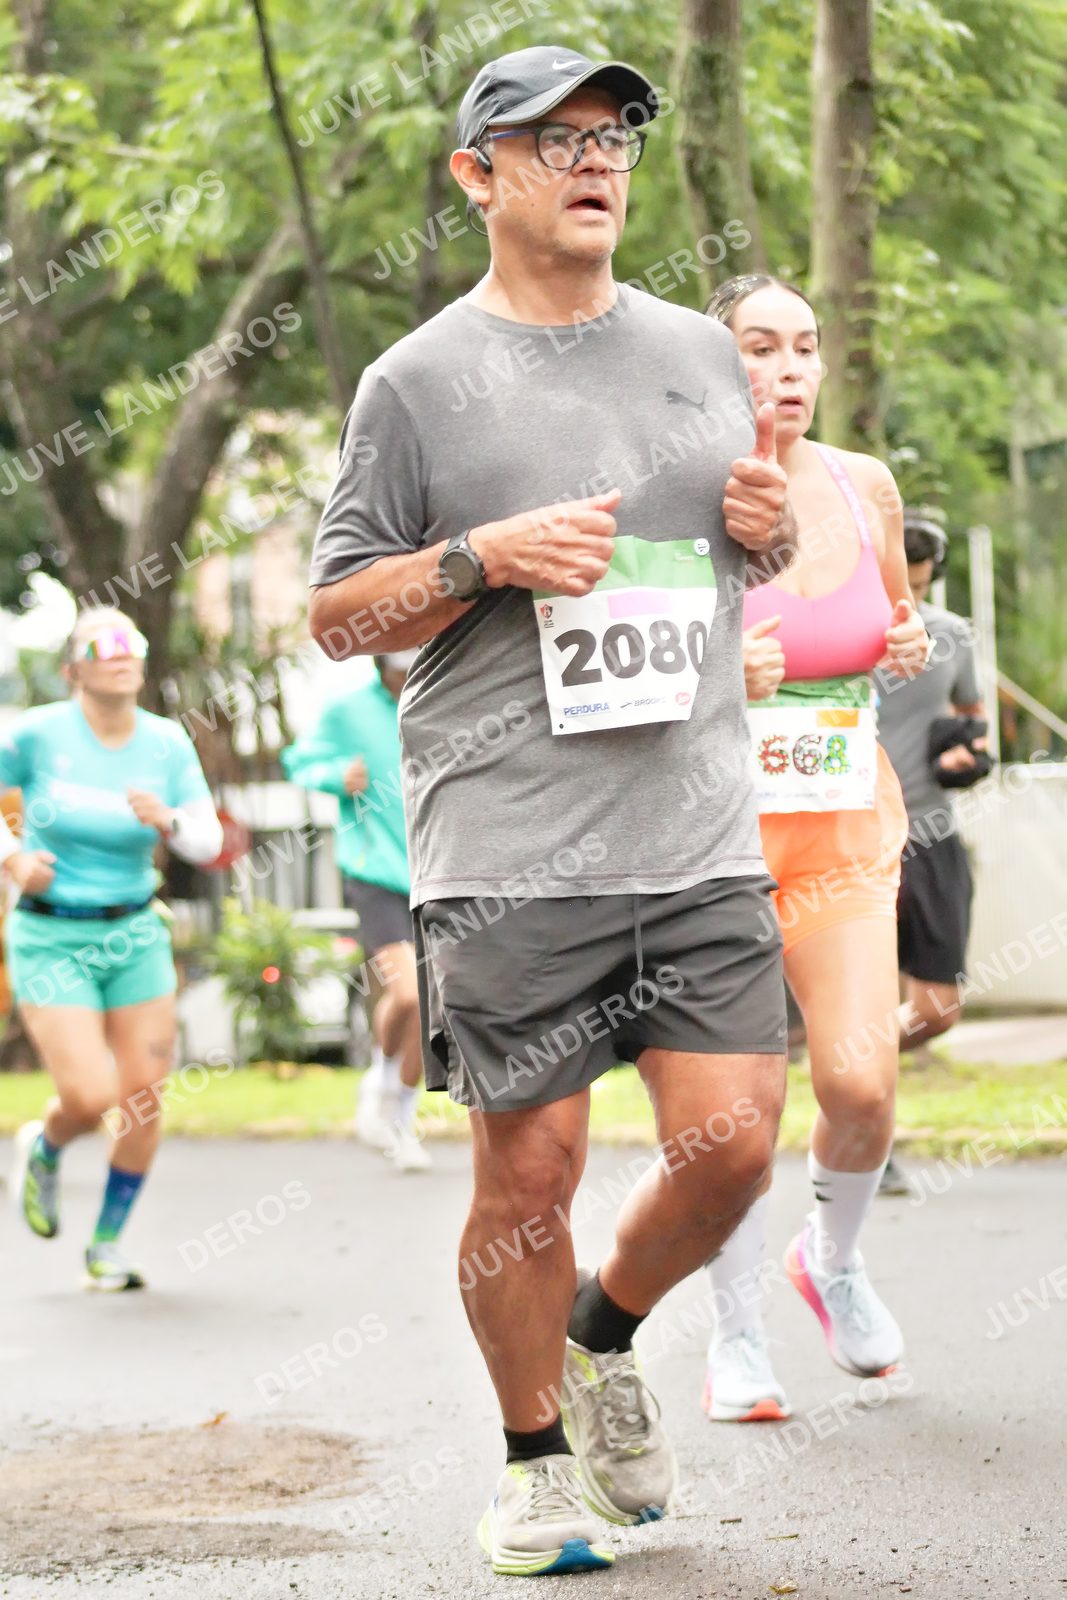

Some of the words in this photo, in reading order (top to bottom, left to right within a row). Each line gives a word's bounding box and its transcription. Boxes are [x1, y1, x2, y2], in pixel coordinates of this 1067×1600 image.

[554, 620, 708, 687] 2080
[564, 702, 610, 716] PERDURA
[757, 734, 852, 776] 668
